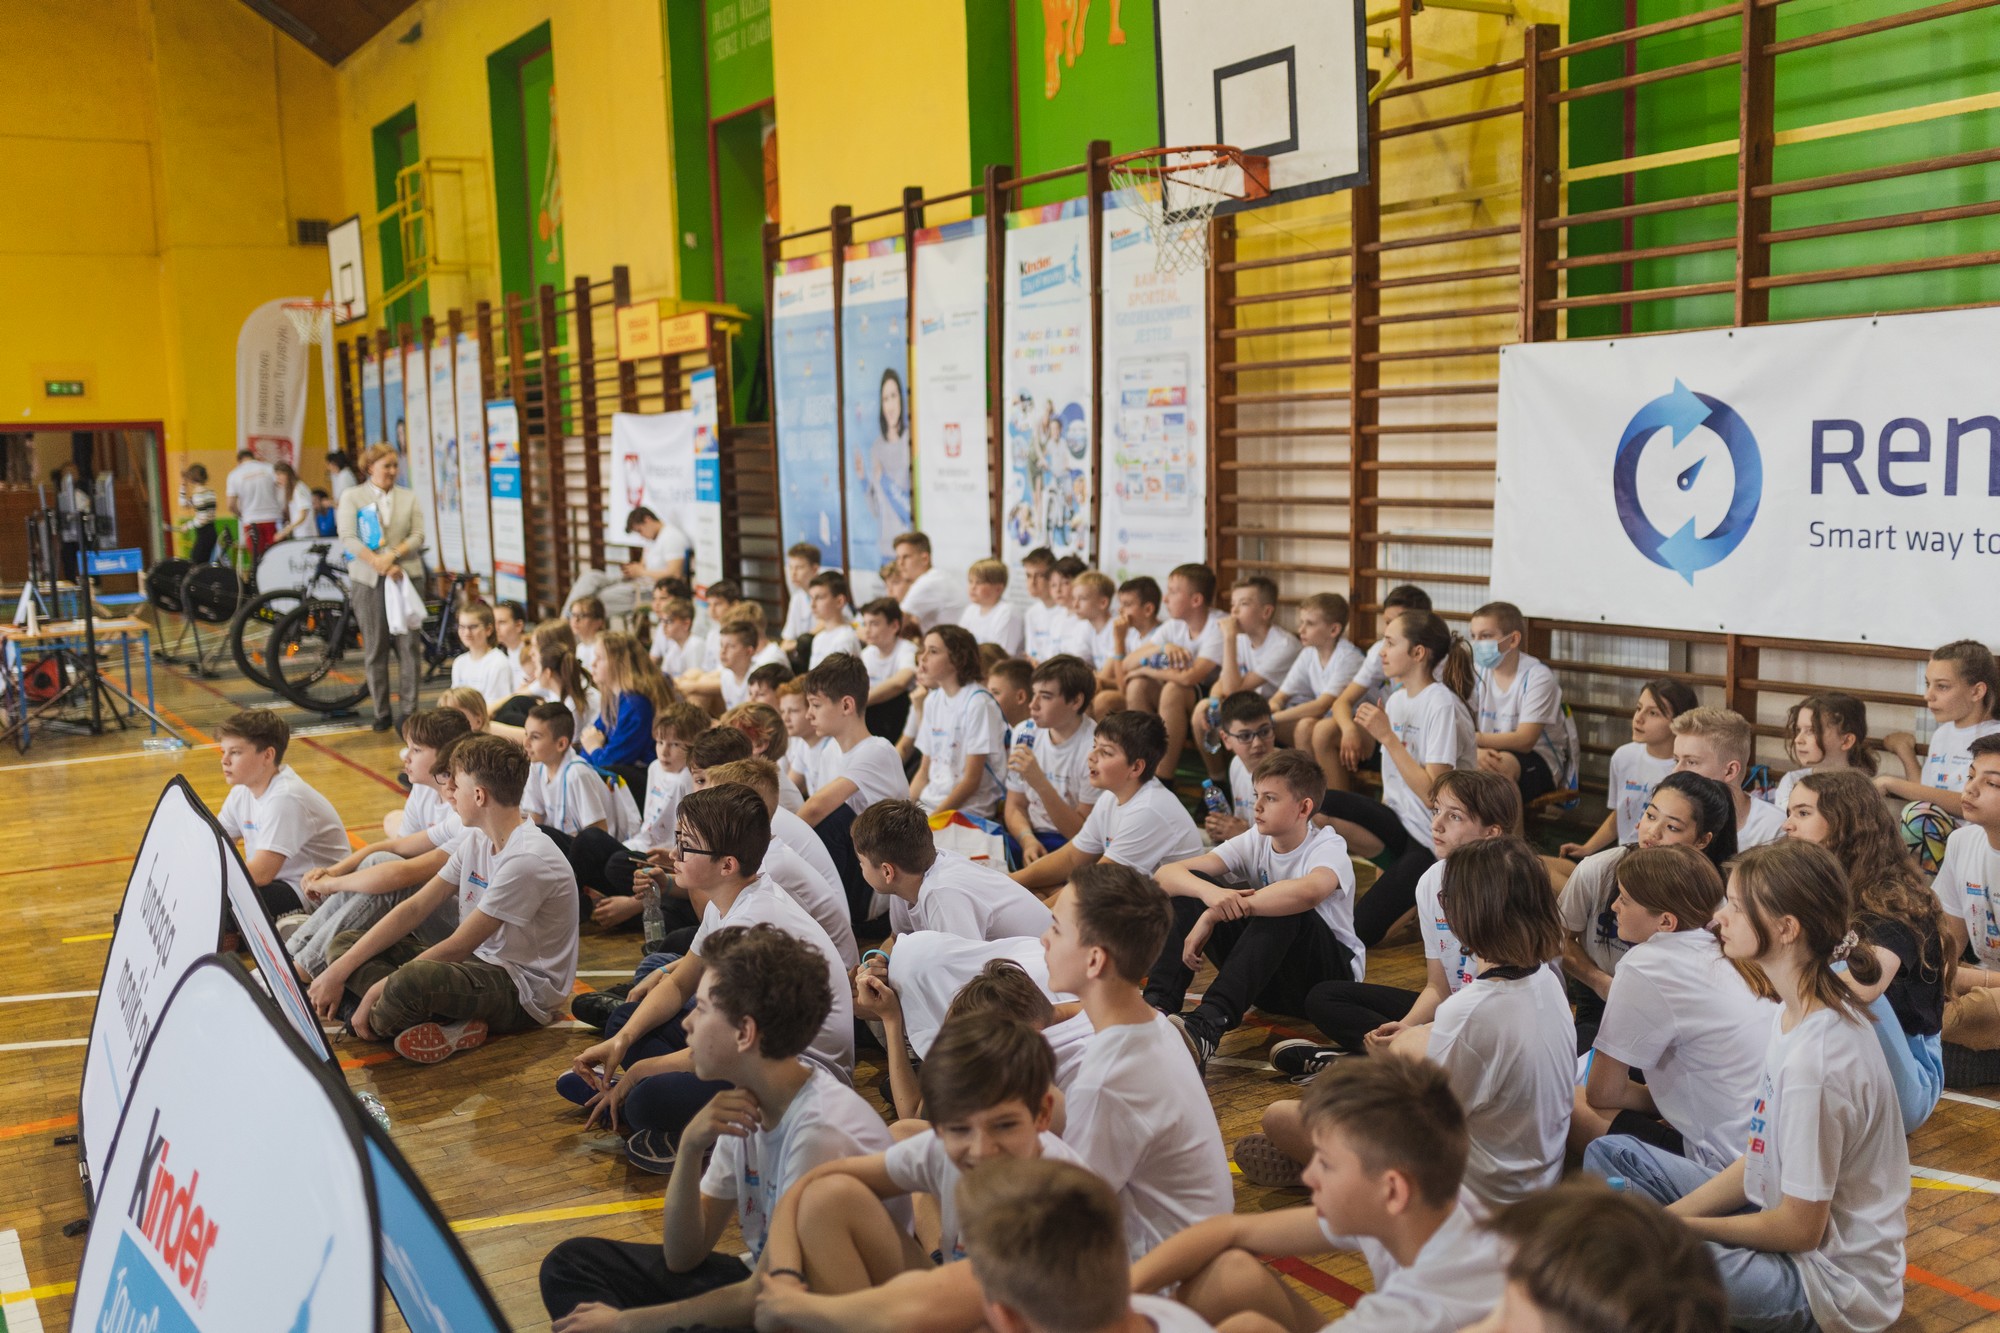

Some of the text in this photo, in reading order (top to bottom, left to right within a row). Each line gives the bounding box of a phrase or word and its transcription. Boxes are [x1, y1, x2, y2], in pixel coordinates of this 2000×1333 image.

[1809, 521, 1897, 550] Smart
[1906, 530, 1964, 561] way
[139, 852, 177, 979] fundacja
[116, 957, 150, 1042] moniki
[127, 1106, 220, 1300] Kinder
